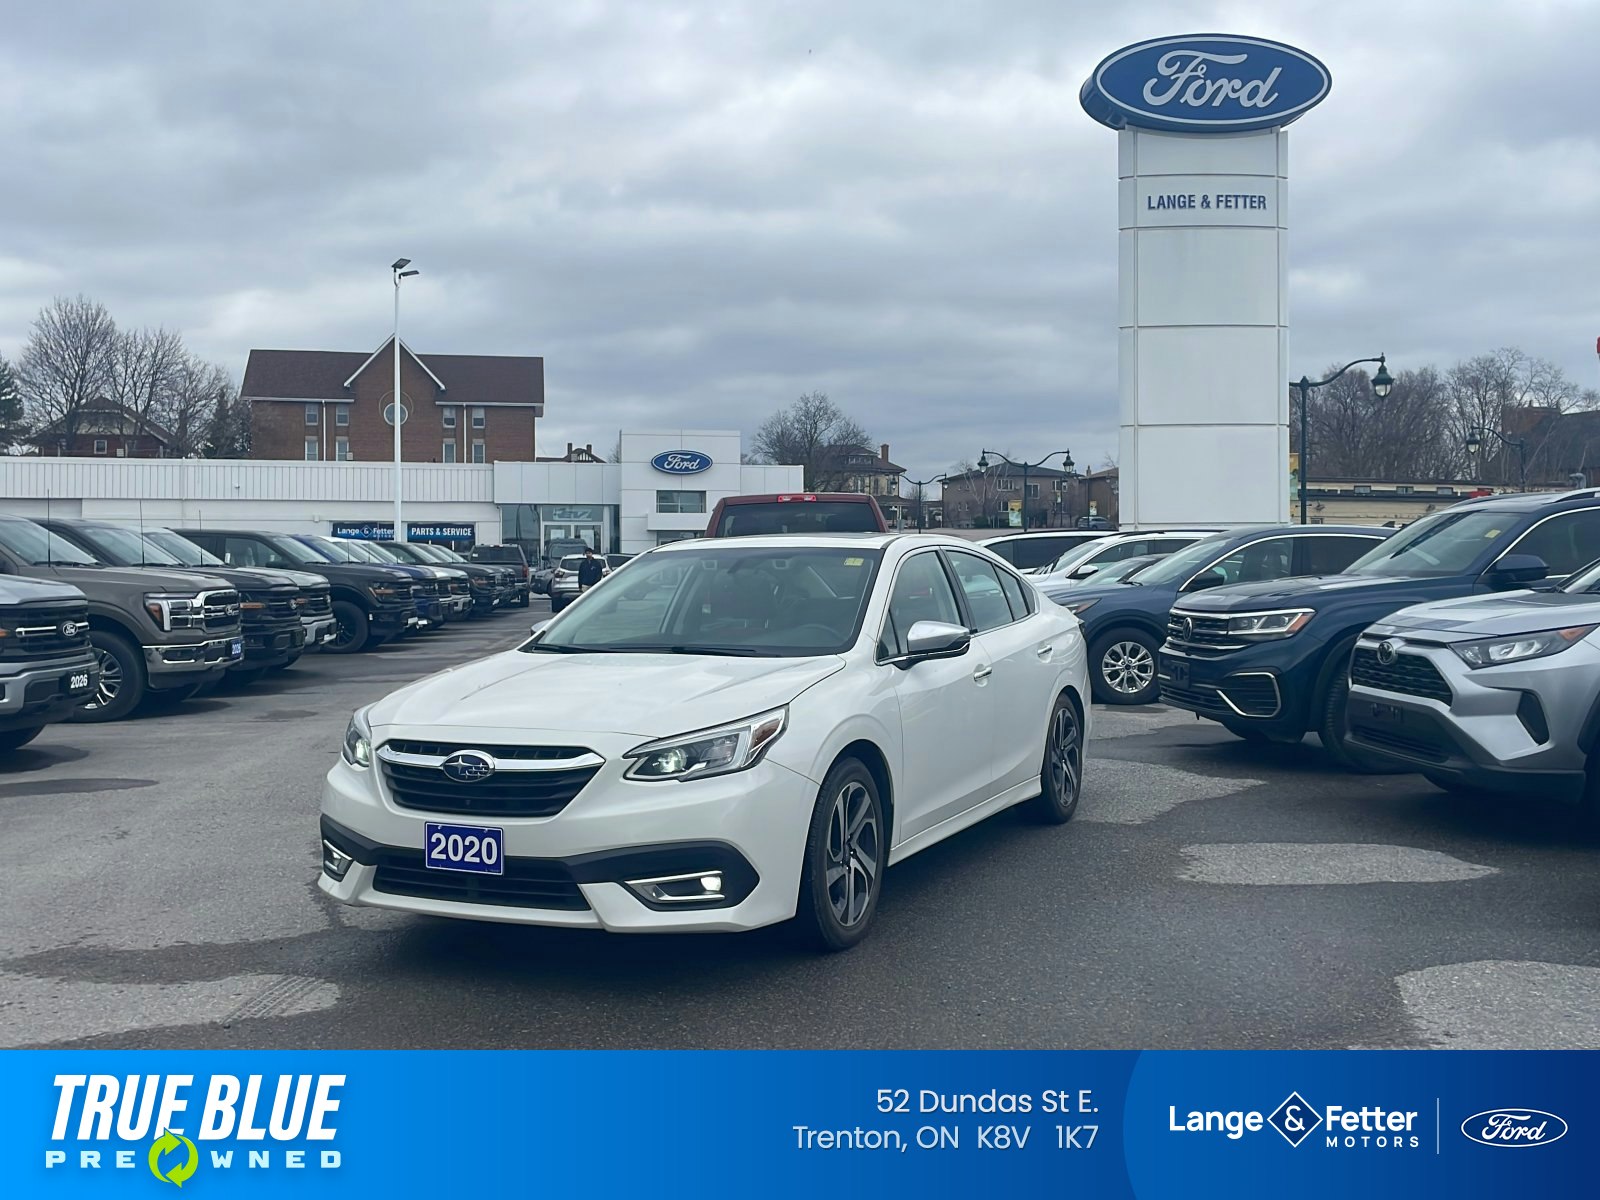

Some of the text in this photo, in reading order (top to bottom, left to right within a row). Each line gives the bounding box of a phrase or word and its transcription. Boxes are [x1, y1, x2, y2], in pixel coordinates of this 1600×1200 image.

[1143, 50, 1282, 108] Ford
[1147, 194, 1267, 210] LANGE & FETTER
[664, 454, 700, 469] Ford
[337, 527, 359, 536] Lange
[373, 527, 394, 535] Fetter
[411, 527, 472, 537] PARTS & SERVICE
[70, 674, 88, 689] 2026
[430, 832, 498, 865] 2020
